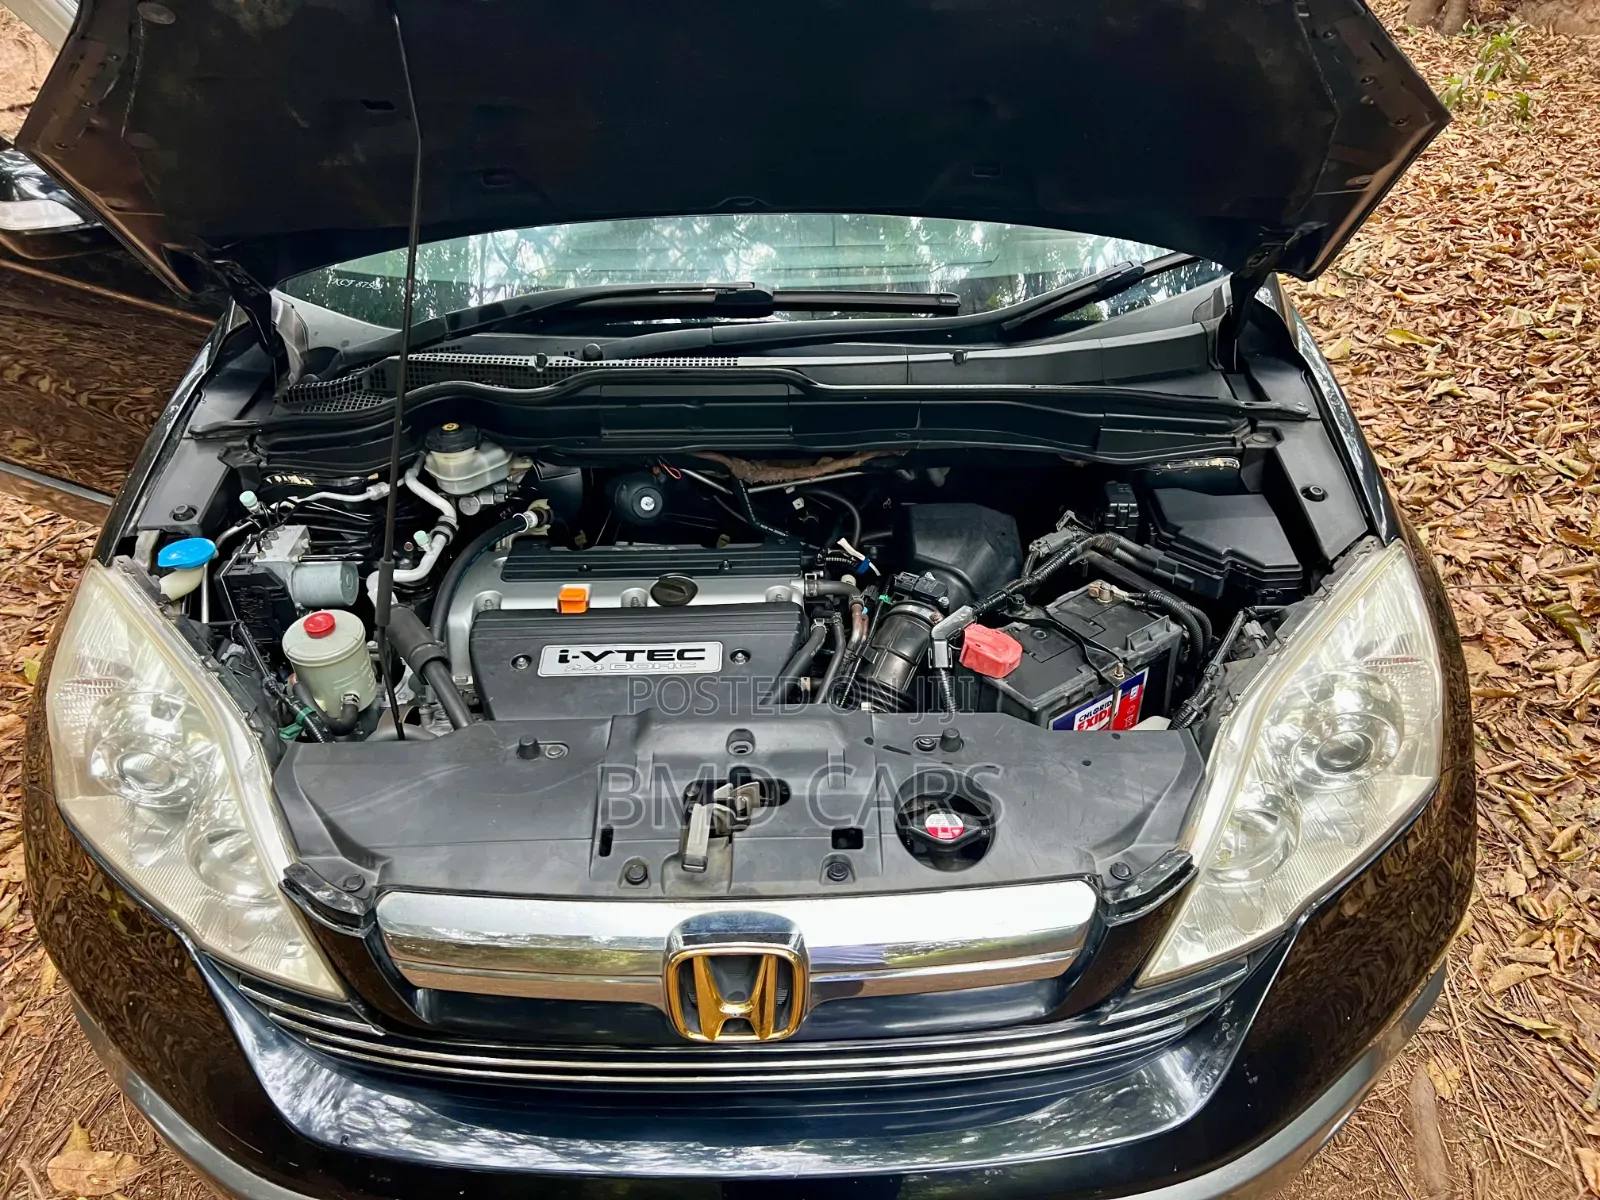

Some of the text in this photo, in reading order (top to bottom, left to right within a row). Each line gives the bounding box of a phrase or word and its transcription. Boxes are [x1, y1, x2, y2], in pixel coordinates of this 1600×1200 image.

[558, 648, 706, 664] i-VTEC
[609, 662, 697, 671] DOHC
[1079, 700, 1114, 722] CHLORID
